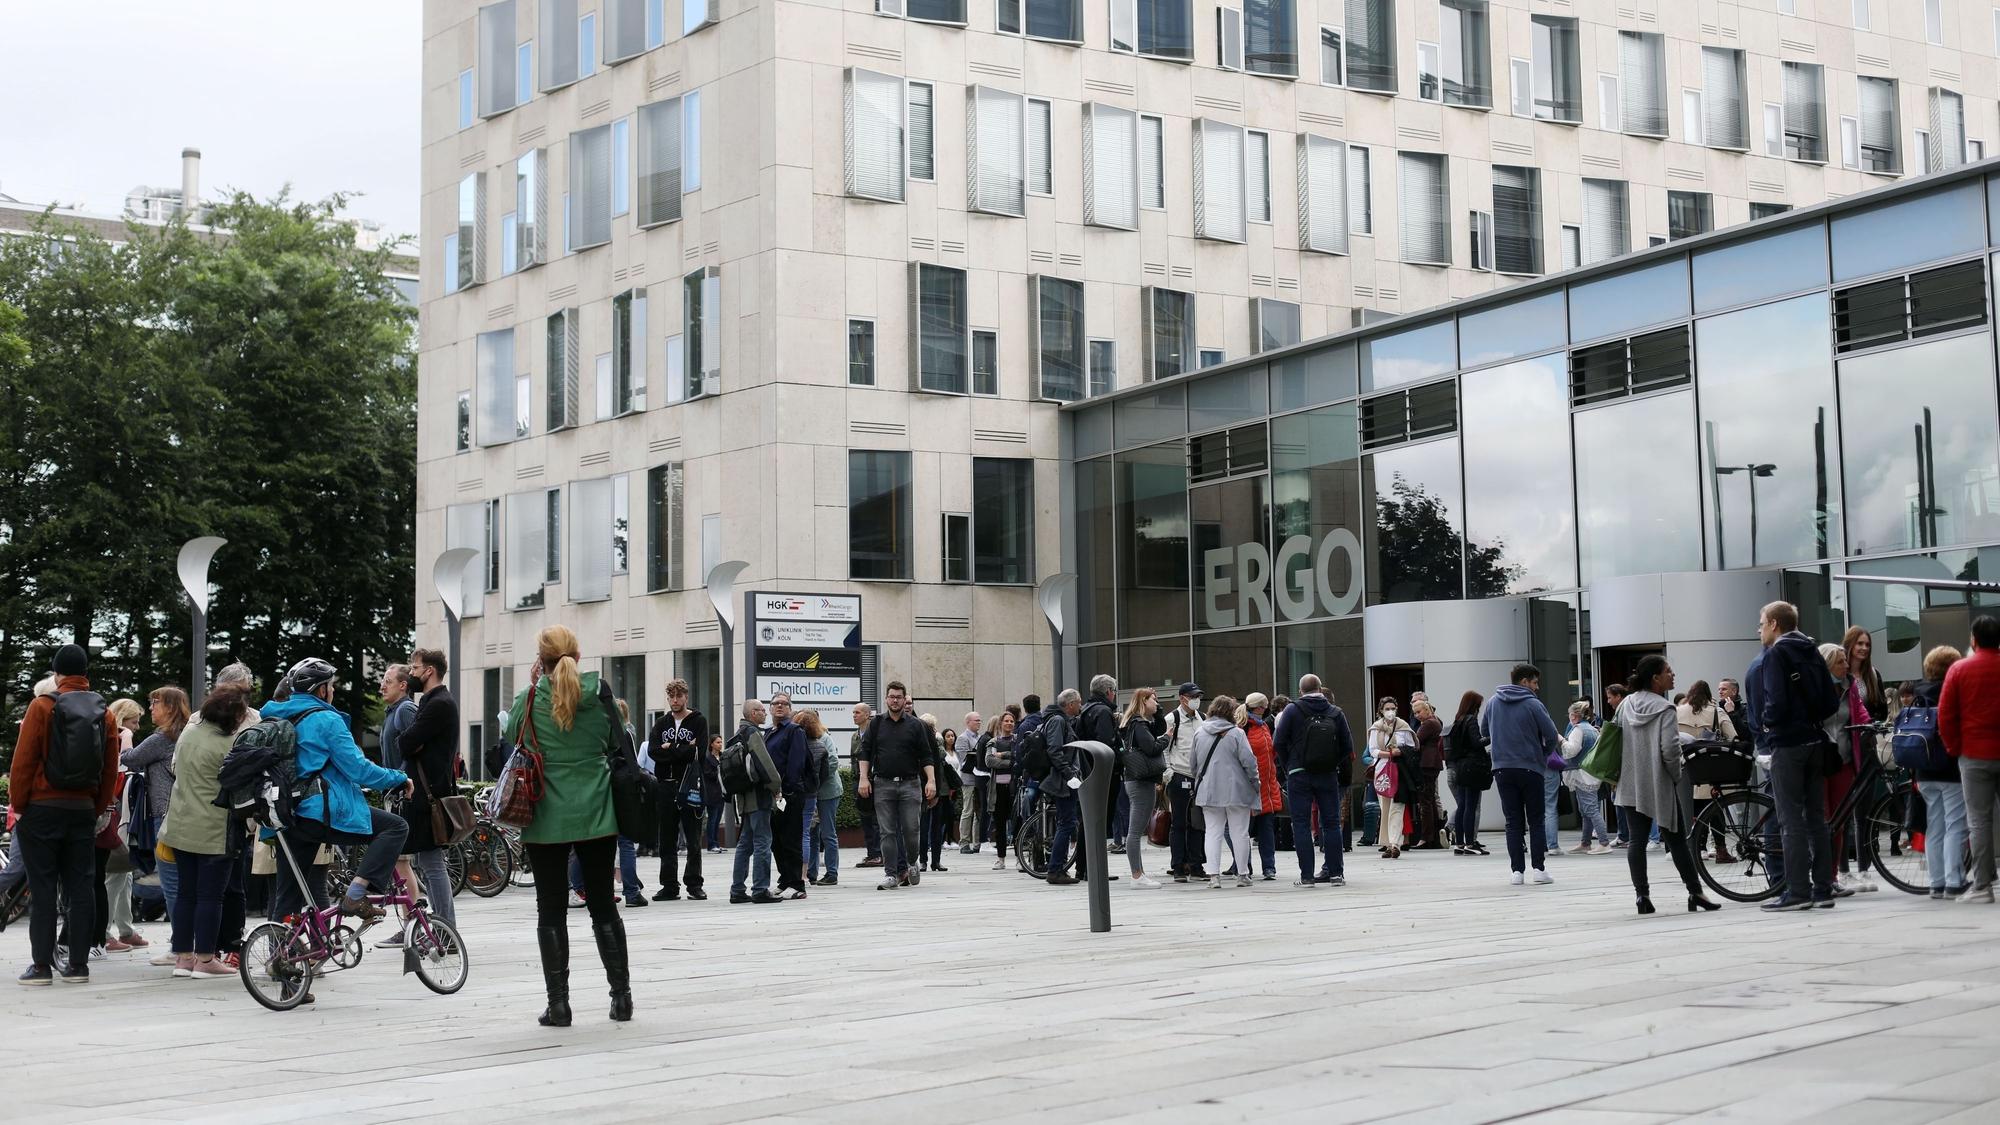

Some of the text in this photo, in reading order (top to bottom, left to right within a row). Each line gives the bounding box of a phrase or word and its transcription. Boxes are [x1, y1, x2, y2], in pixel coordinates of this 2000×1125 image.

[1204, 527, 1363, 629] ERGO
[767, 600, 788, 610] HGK
[762, 660, 805, 670] andagon
[770, 682, 845, 696] Digital River
